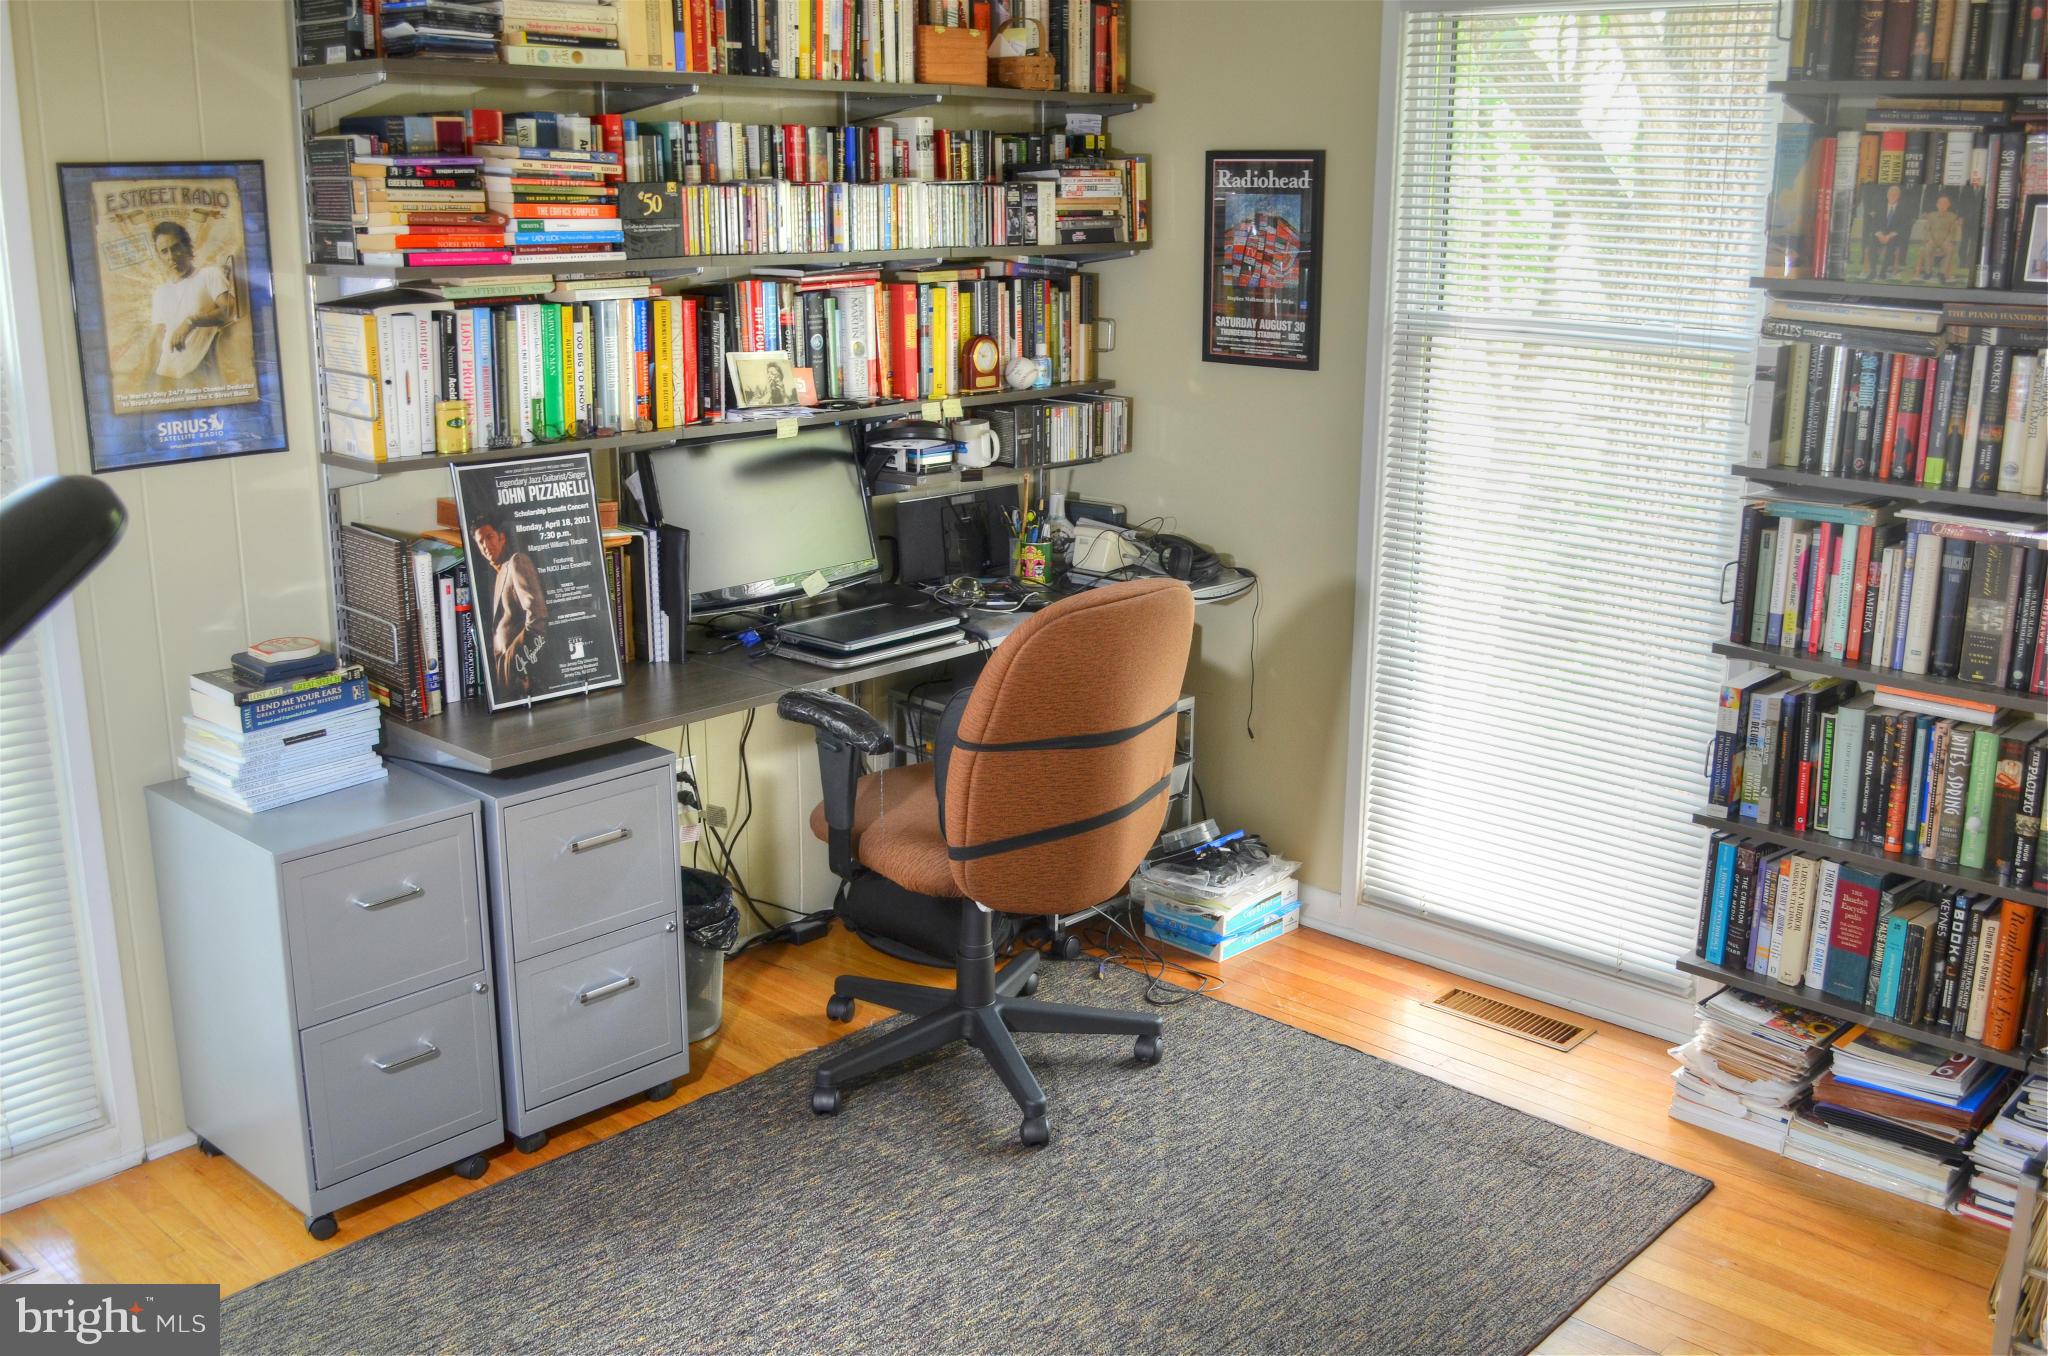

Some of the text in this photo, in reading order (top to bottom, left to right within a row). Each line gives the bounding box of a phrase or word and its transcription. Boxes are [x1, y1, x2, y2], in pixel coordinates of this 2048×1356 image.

[1881, 155, 1891, 183] ENEMY
[1905, 153, 1923, 162] SPIES
[1216, 169, 1311, 189] Radiohead
[1891, 162, 1901, 183] MAIN
[1996, 150, 2016, 210] SPY HANDLER
[118, 186, 231, 209] STREET RADIO
[537, 206, 599, 217] THE EDIFICE COMPLEX
[473, 284, 522, 295] AFTER VIRTUE
[849, 297, 859, 339] MARTIN
[1215, 316, 1306, 333] SATURDAY AUGUST 30
[1947, 310, 1997, 319] THE PIANO
[461, 323, 473, 354] LOST
[547, 309, 557, 377] DARWIN ON MAN
[711, 320, 720, 343] Philip
[1220, 328, 1281, 339] THUNDERBIRD STADIUM
[419, 320, 430, 371] Antifragile
[447, 346, 457, 377] Normal
[1989, 350, 2004, 393] BROKEN
[578, 370, 584, 382] TO
[578, 385, 586, 413] KNOW
[157, 418, 208, 437] SIRIUS
[159, 431, 224, 442] SATELLITE RADIO
[495, 471, 587, 488] Legendary Jazz Guitarist/Singer
[497, 479, 590, 506] JOHN PIZZARELLI
[514, 502, 589, 518] Scholarship Benefit Concert
[515, 515, 591, 533] Monday, April 18, 2011
[539, 530, 571, 540] 7:30 p.m.
[528, 543, 550, 552] Margaret
[1741, 534, 1751, 567] MYSTERY
[570, 561, 592, 569] Ensemble
[1792, 571, 1798, 581] OF
[1982, 545, 1998, 597] Roosevelt
[1789, 582, 1797, 607] MUSIC
[1863, 590, 1874, 633] AMERICA
[2016, 585, 2032, 659] AMERICAN REVOLUTION
[2027, 600, 2037, 638] RADICALISM
[250, 686, 283, 701] LOST ART
[255, 686, 343, 713] LEND ME YOUR EARS
[256, 710, 276, 719] GREAT
[277, 703, 307, 716] SPEECHES
[317, 694, 342, 706] HISTORY
[257, 708, 318, 726] Revised and Expanded Edition
[1750, 699, 1763, 747] GREAT DELUGE
[1716, 742, 1724, 761] WORLD
[1721, 736, 1732, 789] THE GLOBALIZATION
[1762, 744, 1770, 766] POLITICS
[1823, 720, 1833, 778] JAZZ MASTERS OF
[1895, 720, 1908, 790] CULTURAL SELECTION
[1799, 727, 1810, 804] TRANSFORMING INTELLIGENCE
[1864, 750, 1874, 776] CHINA
[1943, 735, 1969, 816] RITES SPRING
[1745, 772, 1754, 801] BRINKLEY
[1752, 774, 1761, 801] DOUGLAS
[2022, 751, 2041, 814] THE PACIFIC
[2014, 837, 2024, 866] AMBROSE
[2022, 844, 2030, 862] HUGH
[1734, 874, 1740, 883] OF
[1796, 869, 1808, 901] DISTANT
[1763, 881, 1771, 905] FLANNERY
[1787, 862, 1800, 929] BARBARA W. TUCHMAN
[1712, 872, 1728, 950] HISTORY OF PSYCHOLOGY
[1730, 900, 1738, 921] MEDIA
[1737, 892, 1747, 924] CREATION
[1792, 902, 1805, 931] MIRROR
[1936, 899, 1951, 937] KEYNES
[1776, 913, 1786, 936] JOURNEY
[1812, 869, 1836, 977] THOMAS E. RICKS THE GAMBLE
[1877, 923, 1888, 942] FALSE
[1949, 909, 1966, 956] BOOK
[1967, 935, 1978, 964] AVOIDING
[1984, 926, 1995, 949] Claude
[1874, 943, 1885, 962] DAWN
[1967, 965, 1975, 977] THE
[1991, 911, 2028, 1040] Rembrandt's Eyes
[1962, 977, 1973, 1009] APOCALYPSE
